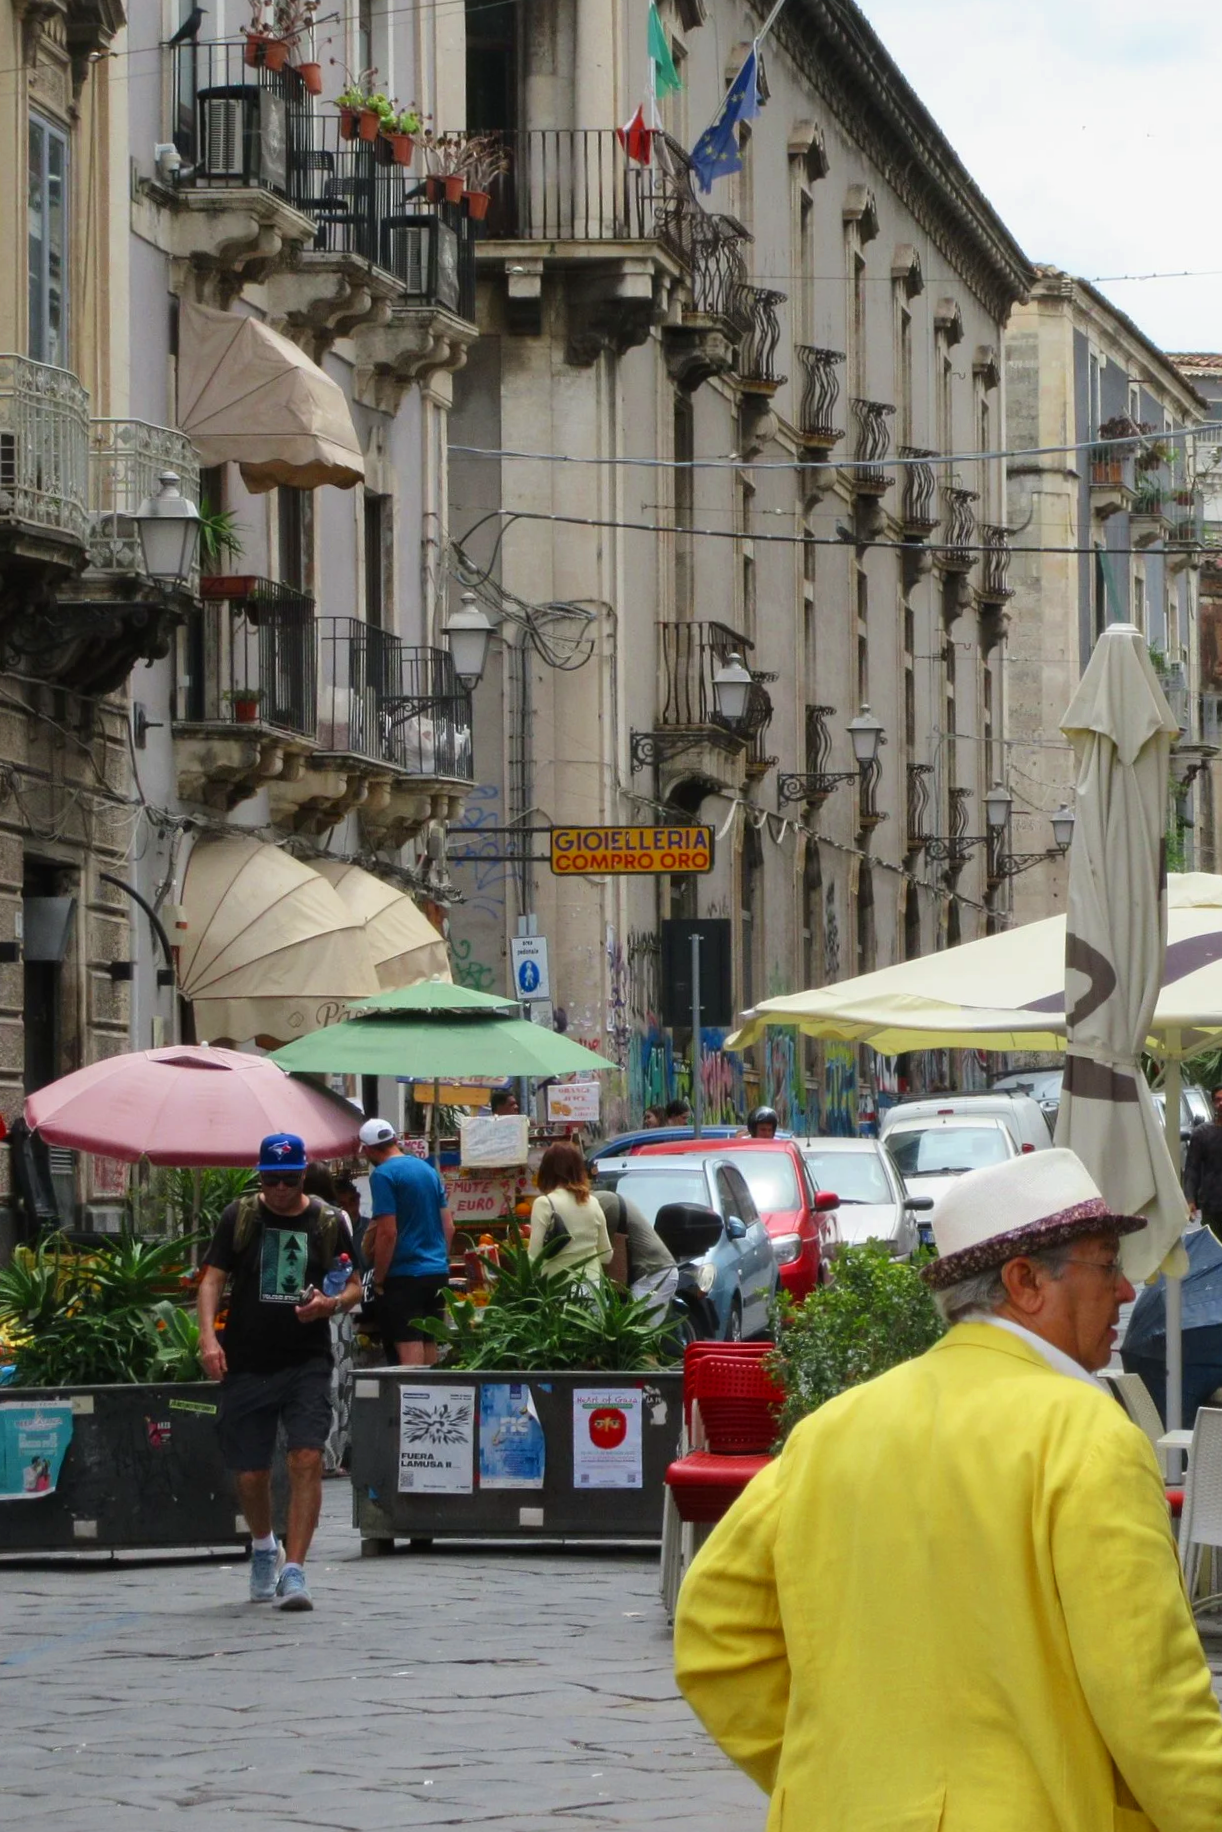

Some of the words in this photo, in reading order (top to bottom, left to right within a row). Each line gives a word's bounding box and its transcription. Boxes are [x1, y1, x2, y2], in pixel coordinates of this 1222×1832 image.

[555, 831, 707, 851] GIOIELLERIA
[556, 852, 654, 870] COMPRO
[660, 852, 708, 868] ORO
[457, 1199, 495, 1212] EURO
[401, 1452, 434, 1460] FUERA
[401, 1460, 444, 1468] LAMUSA
